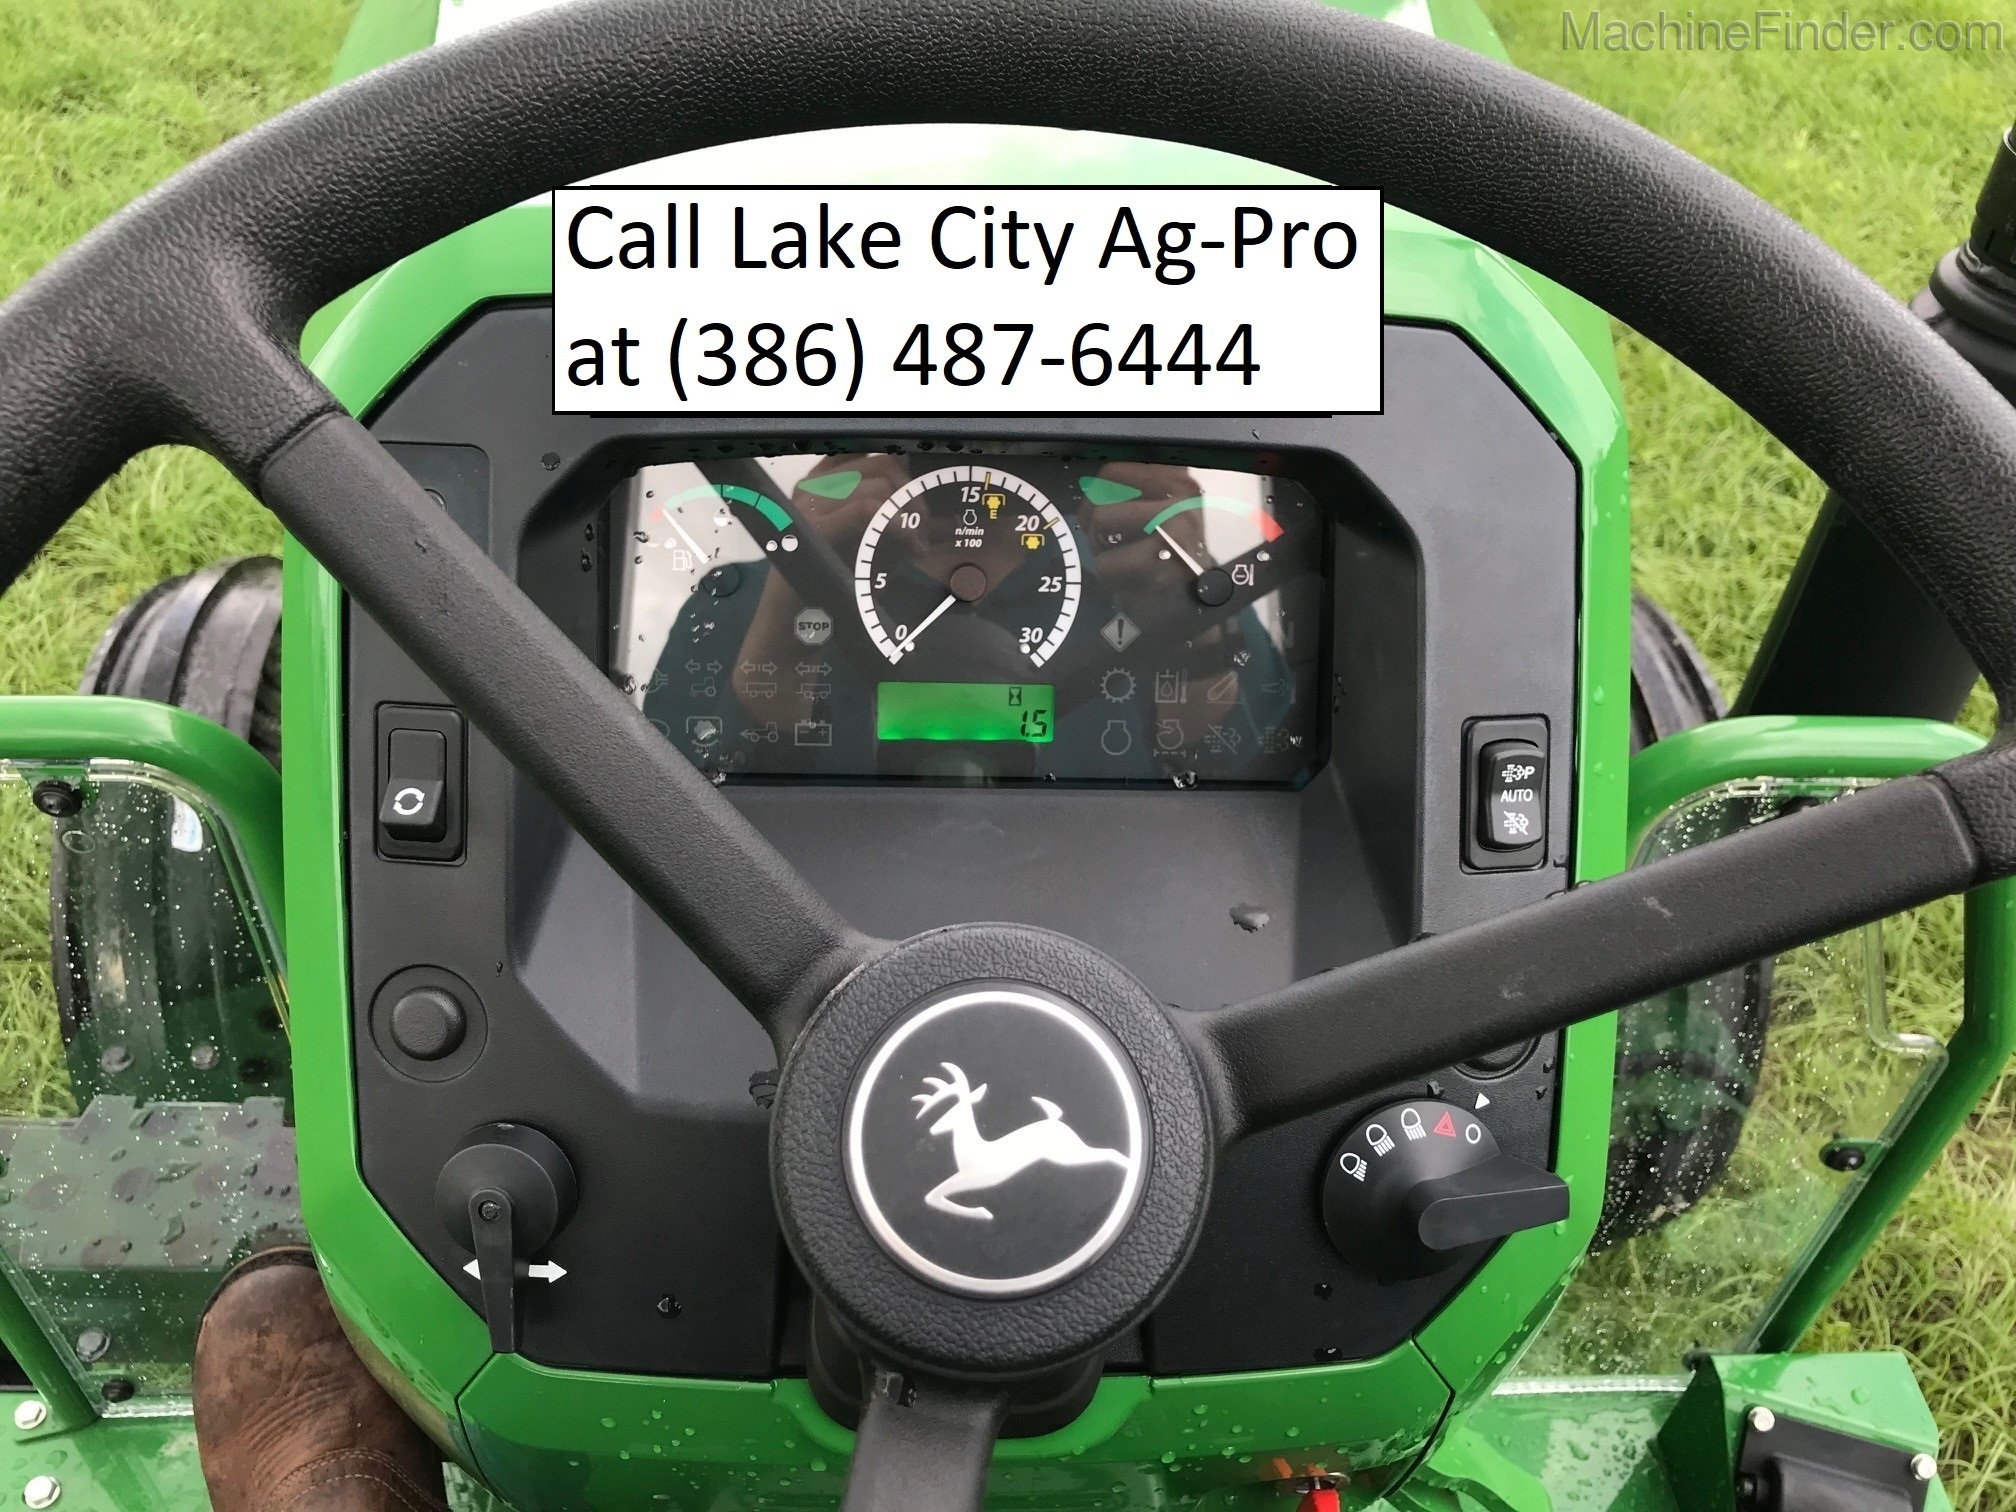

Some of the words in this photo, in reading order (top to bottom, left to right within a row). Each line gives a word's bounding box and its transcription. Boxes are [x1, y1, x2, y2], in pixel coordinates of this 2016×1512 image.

[961, 486, 981, 503] 15
[900, 512, 921, 529] 10
[990, 510, 997, 519] E
[1015, 514, 1040, 531] 20
[955, 526, 984, 536] n/min
[964, 538, 982, 548] 100
[874, 573, 887, 589] 5
[1038, 576, 1063, 593] 25
[798, 621, 830, 631] STOP
[895, 624, 908, 641] 0
[1018, 627, 1043, 644] 30
[1500, 788, 1533, 802] AUTO
